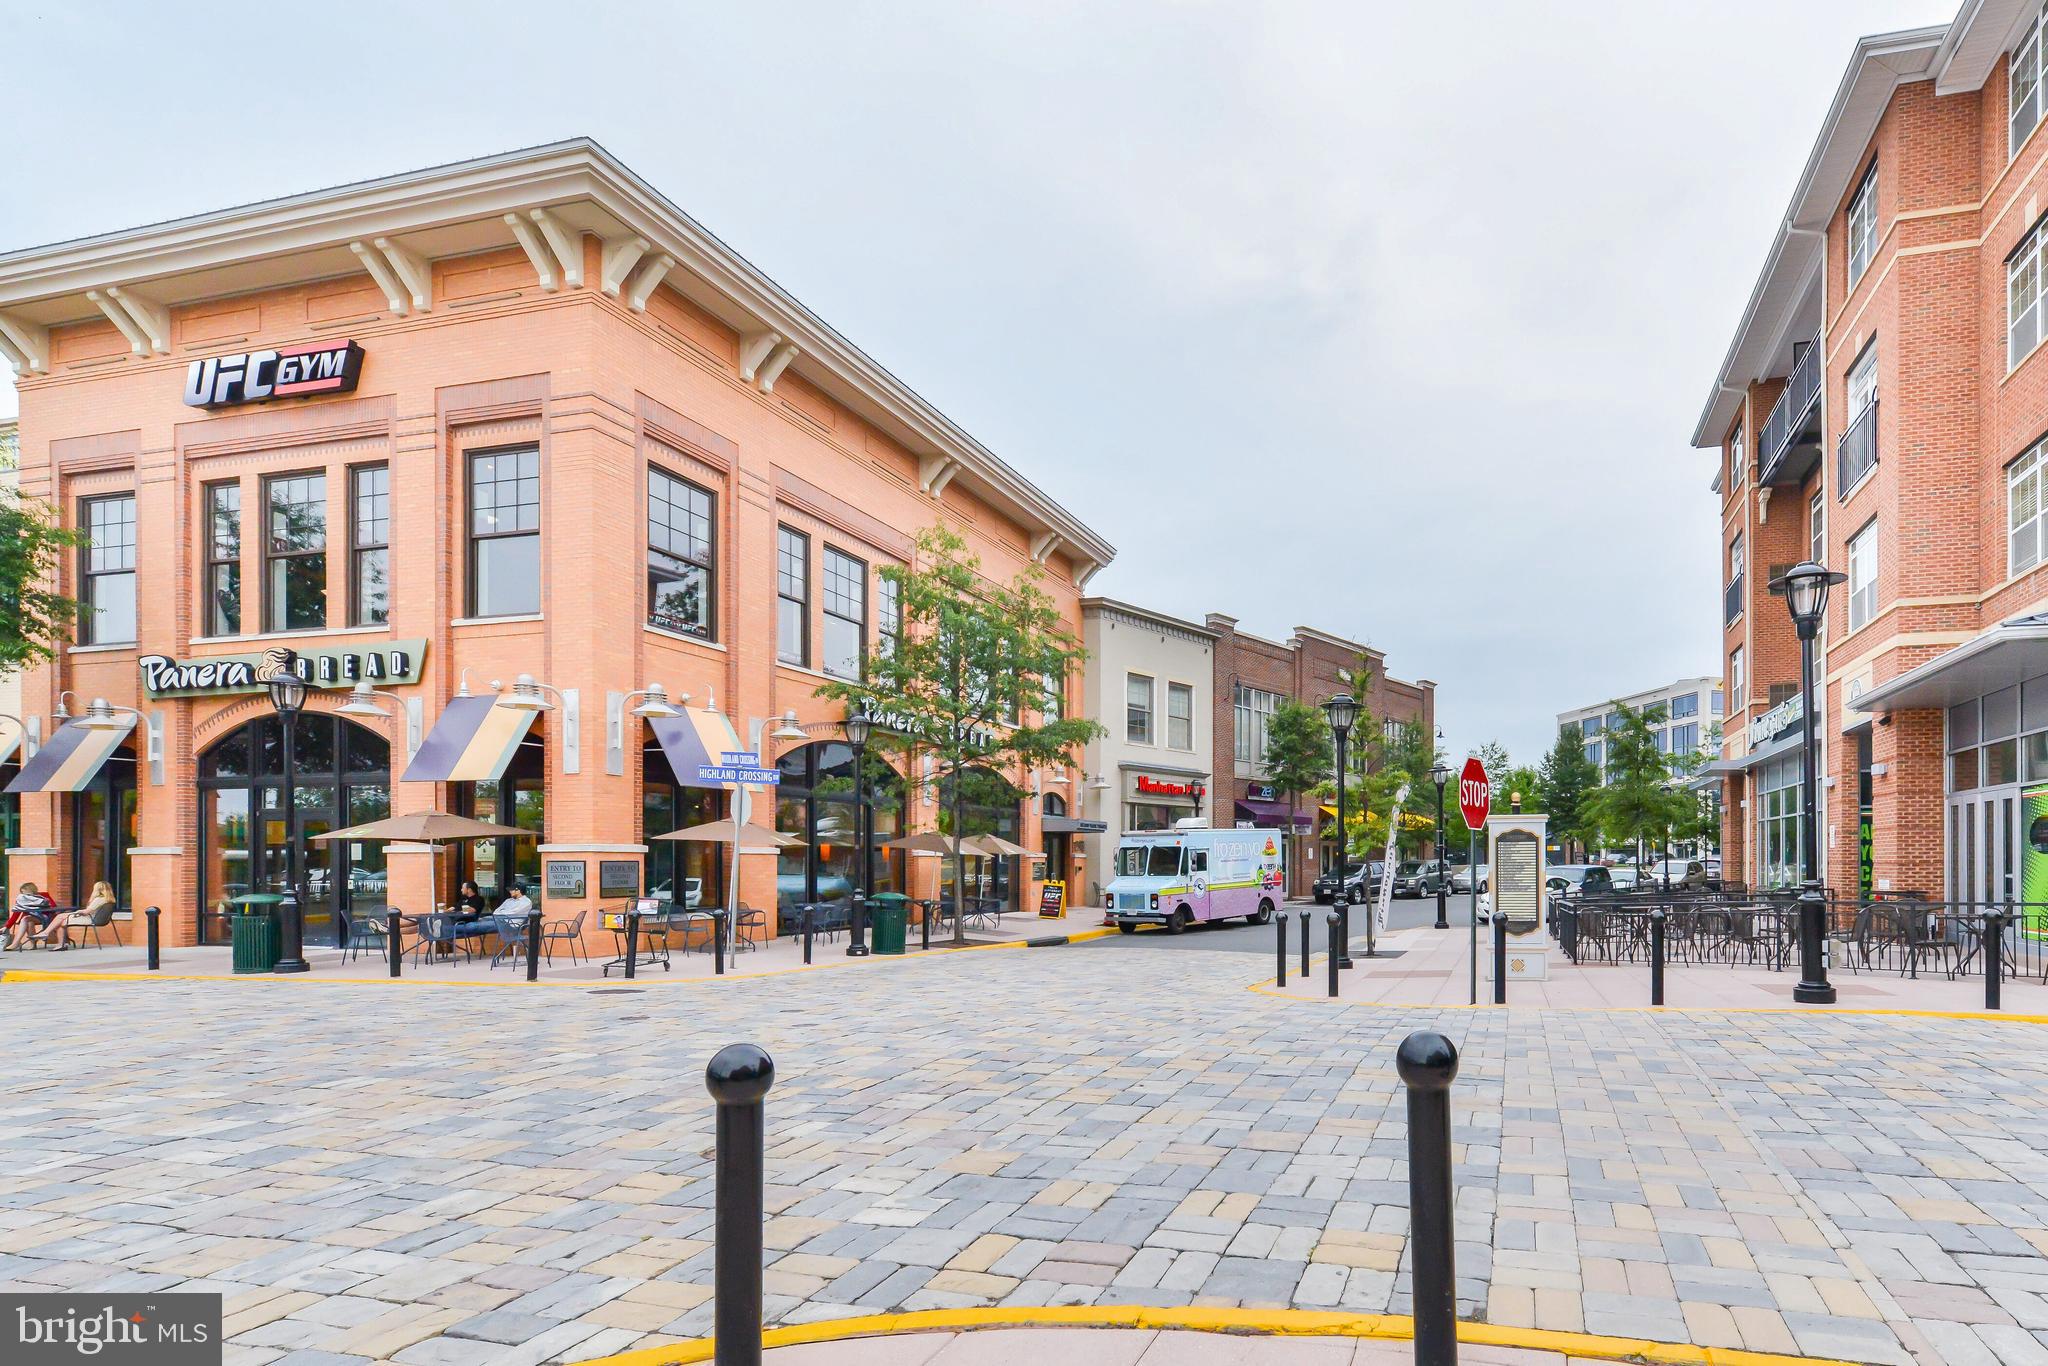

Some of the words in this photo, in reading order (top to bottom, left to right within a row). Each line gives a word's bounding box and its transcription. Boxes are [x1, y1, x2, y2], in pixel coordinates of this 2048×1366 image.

[183, 350, 278, 405] UFC
[277, 350, 348, 384] GYM
[139, 655, 249, 691] Panera
[297, 651, 405, 681] BREAD
[699, 767, 736, 780] HIGHLAND
[738, 770, 773, 782] CROSSING
[1137, 775, 1184, 795] Manhattan
[1462, 779, 1488, 808] STOP
